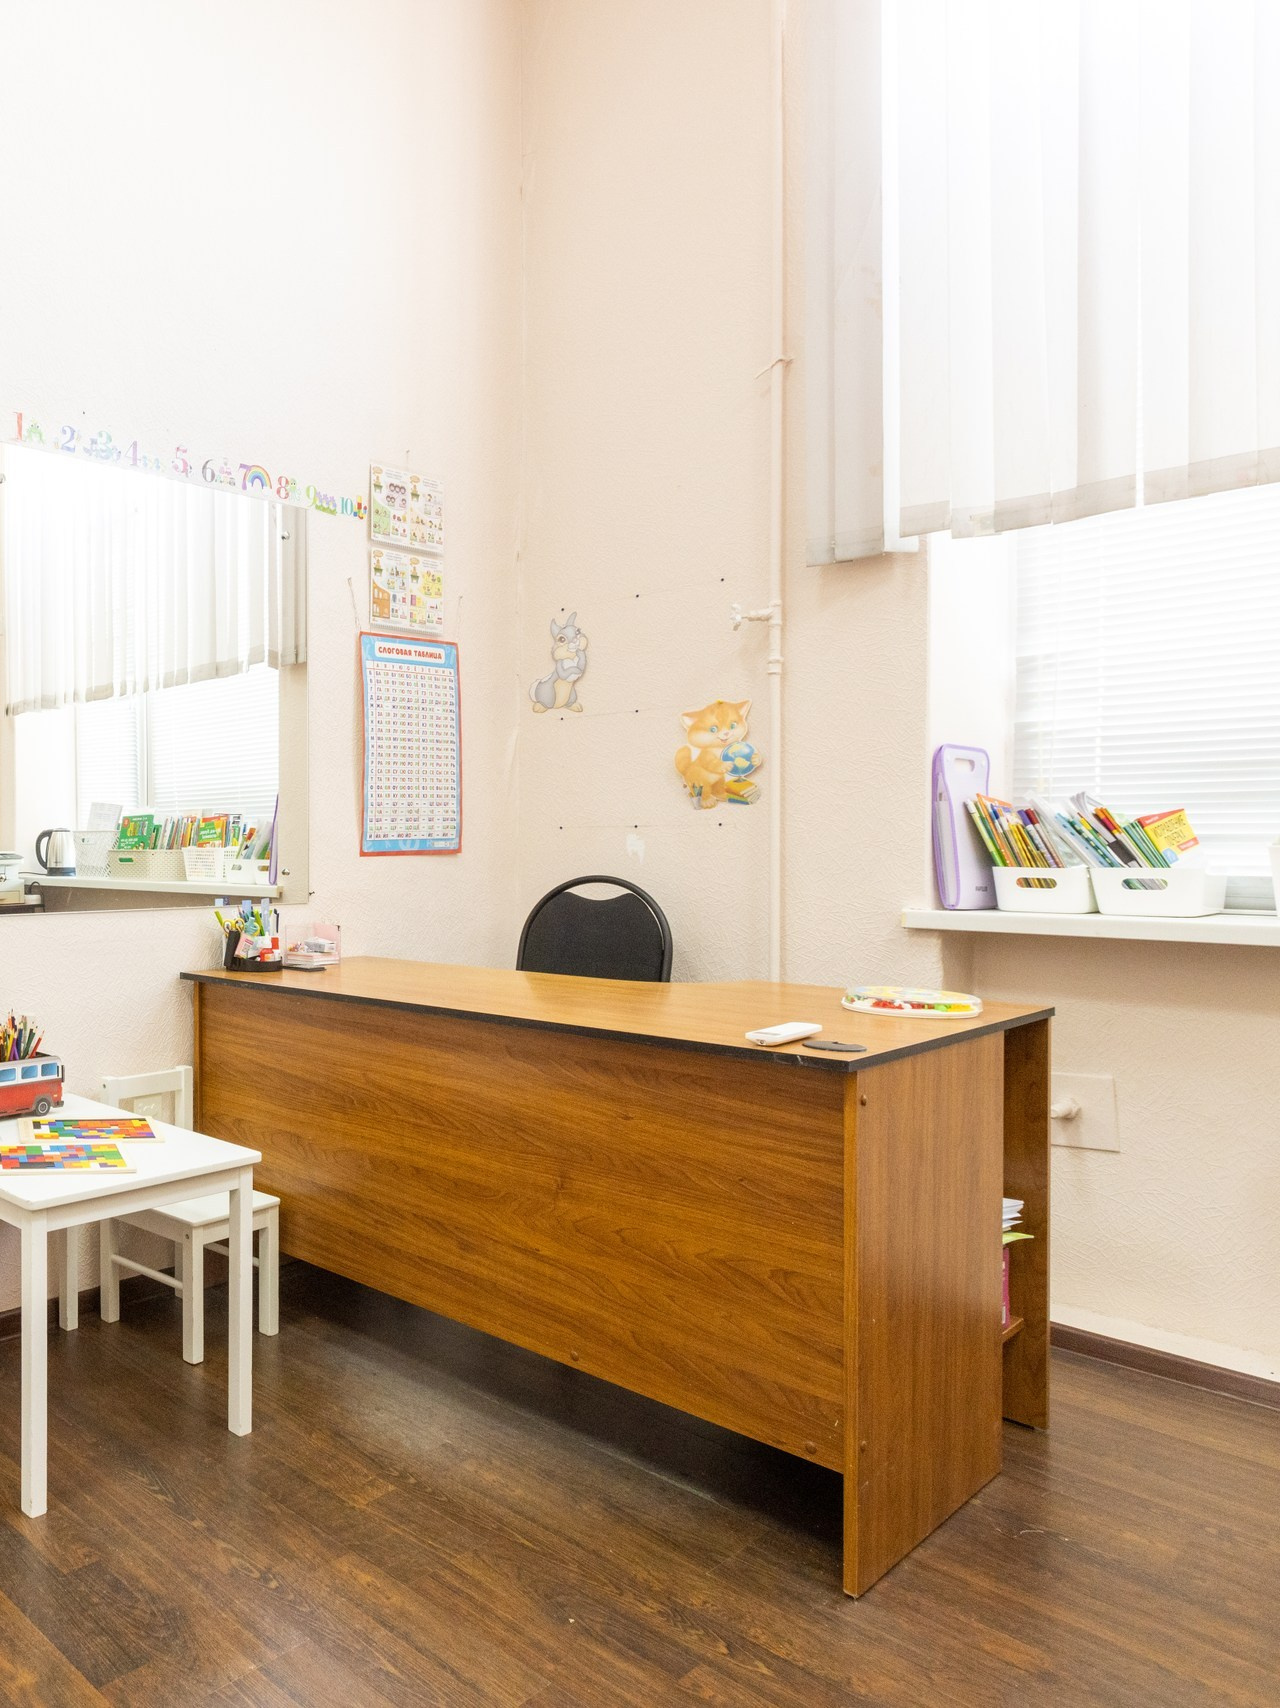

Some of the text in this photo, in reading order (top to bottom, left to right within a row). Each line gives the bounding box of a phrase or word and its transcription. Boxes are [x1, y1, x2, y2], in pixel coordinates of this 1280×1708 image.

[12, 412, 23, 441] 1
[61, 425, 76, 453] 2
[97, 430, 113, 460] 3
[124, 440, 141, 466] 4
[175, 445, 189, 473] 5
[202, 459, 216, 483] 6
[239, 463, 251, 490] 7
[277, 476, 289, 499] 8
[305, 485, 317, 507] 9
[340, 496, 353, 516] 10
[378, 646, 442, 659] СЛОГОВАЯ ТАБЛИЦА
